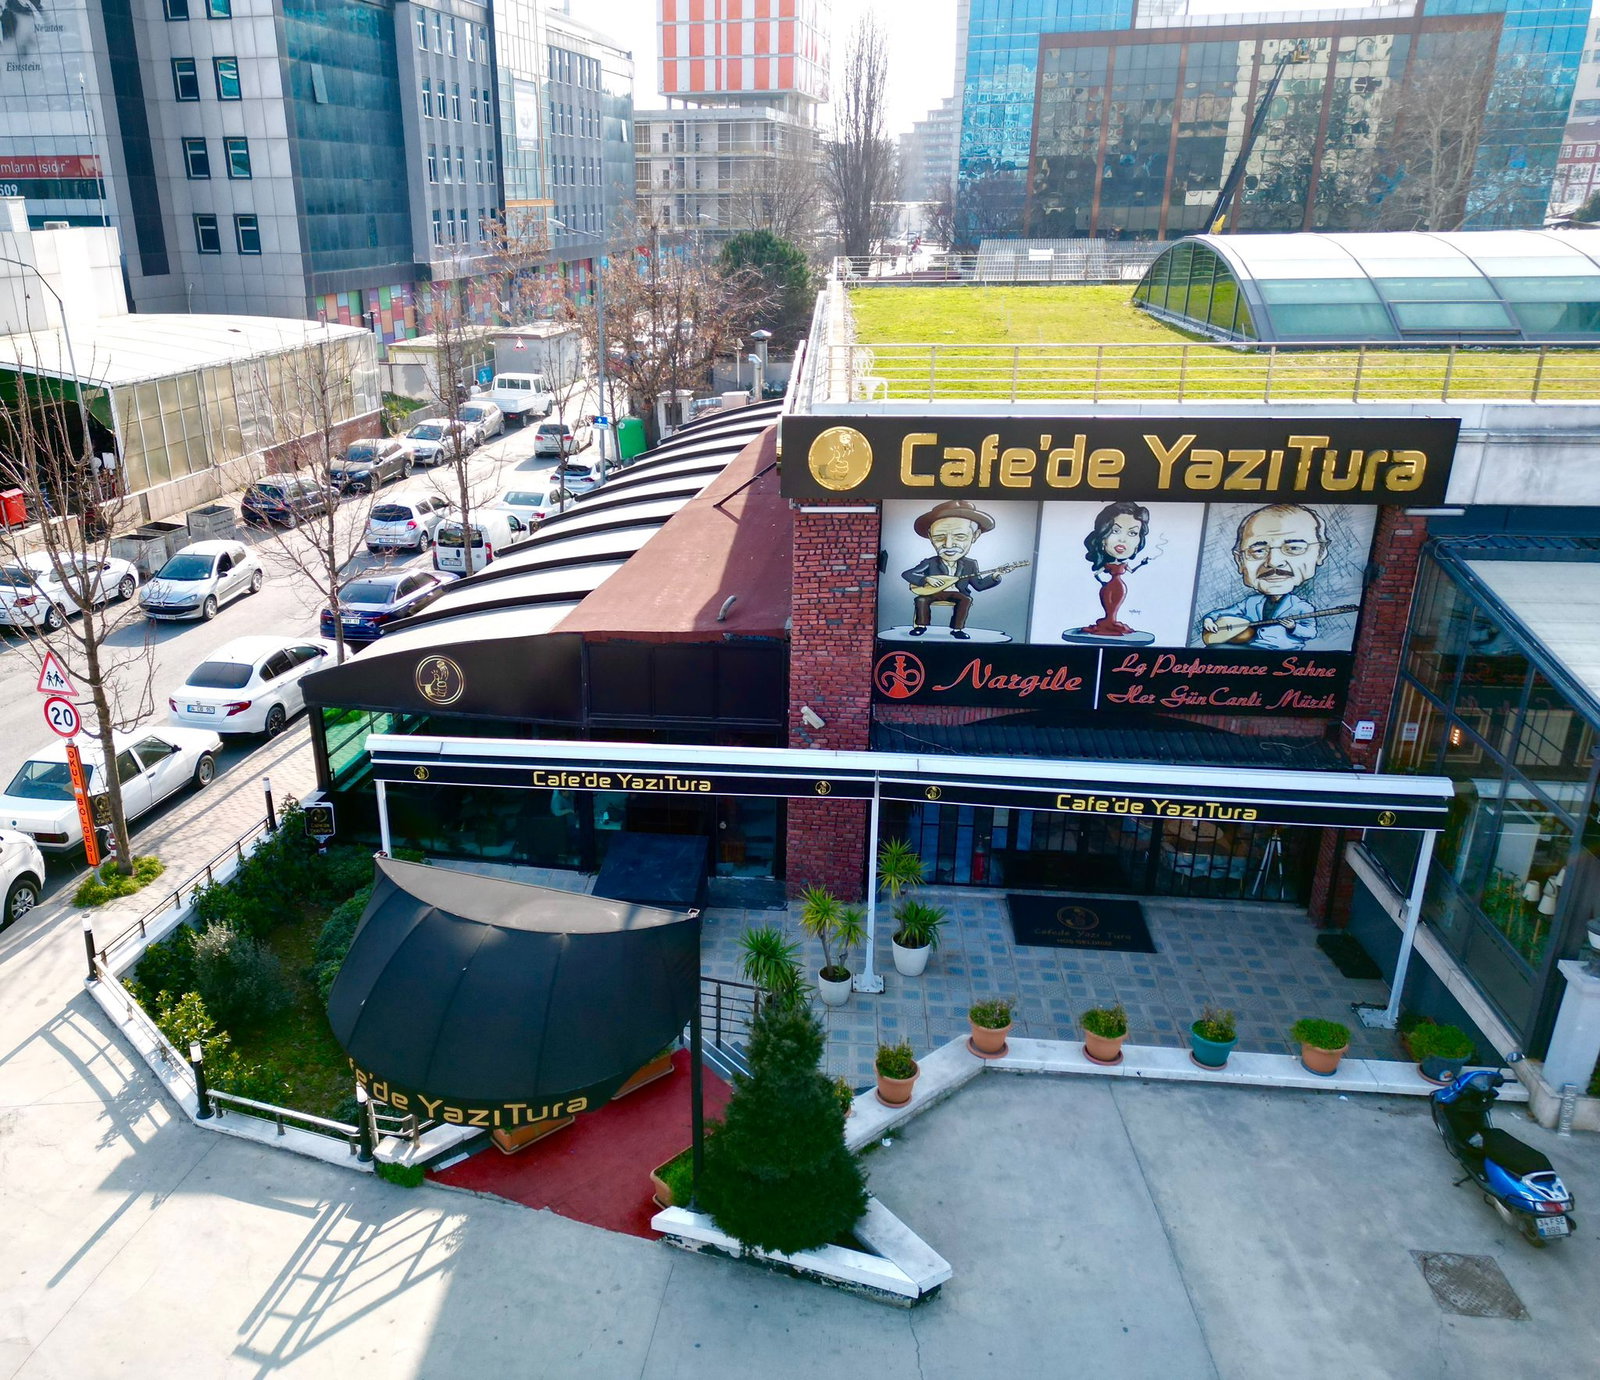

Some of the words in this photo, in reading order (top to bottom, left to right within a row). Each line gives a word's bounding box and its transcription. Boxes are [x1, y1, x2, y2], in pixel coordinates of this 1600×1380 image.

[6, 61, 41, 72] Einstein
[900, 432, 1126, 489] Cafe'de
[931, 657, 1083, 698] Nargile
[1150, 654, 1268, 678] Performance
[1272, 656, 1336, 678] Sahne
[1107, 685, 1156, 704] Her
[1160, 686, 1207, 708] Gün
[1265, 689, 1336, 710] Müzik
[51, 707, 73, 727] 20
[67, 751, 80, 787] OKUL
[533, 771, 611, 787] Cafe'de
[1056, 794, 1145, 814] Cafe'de
